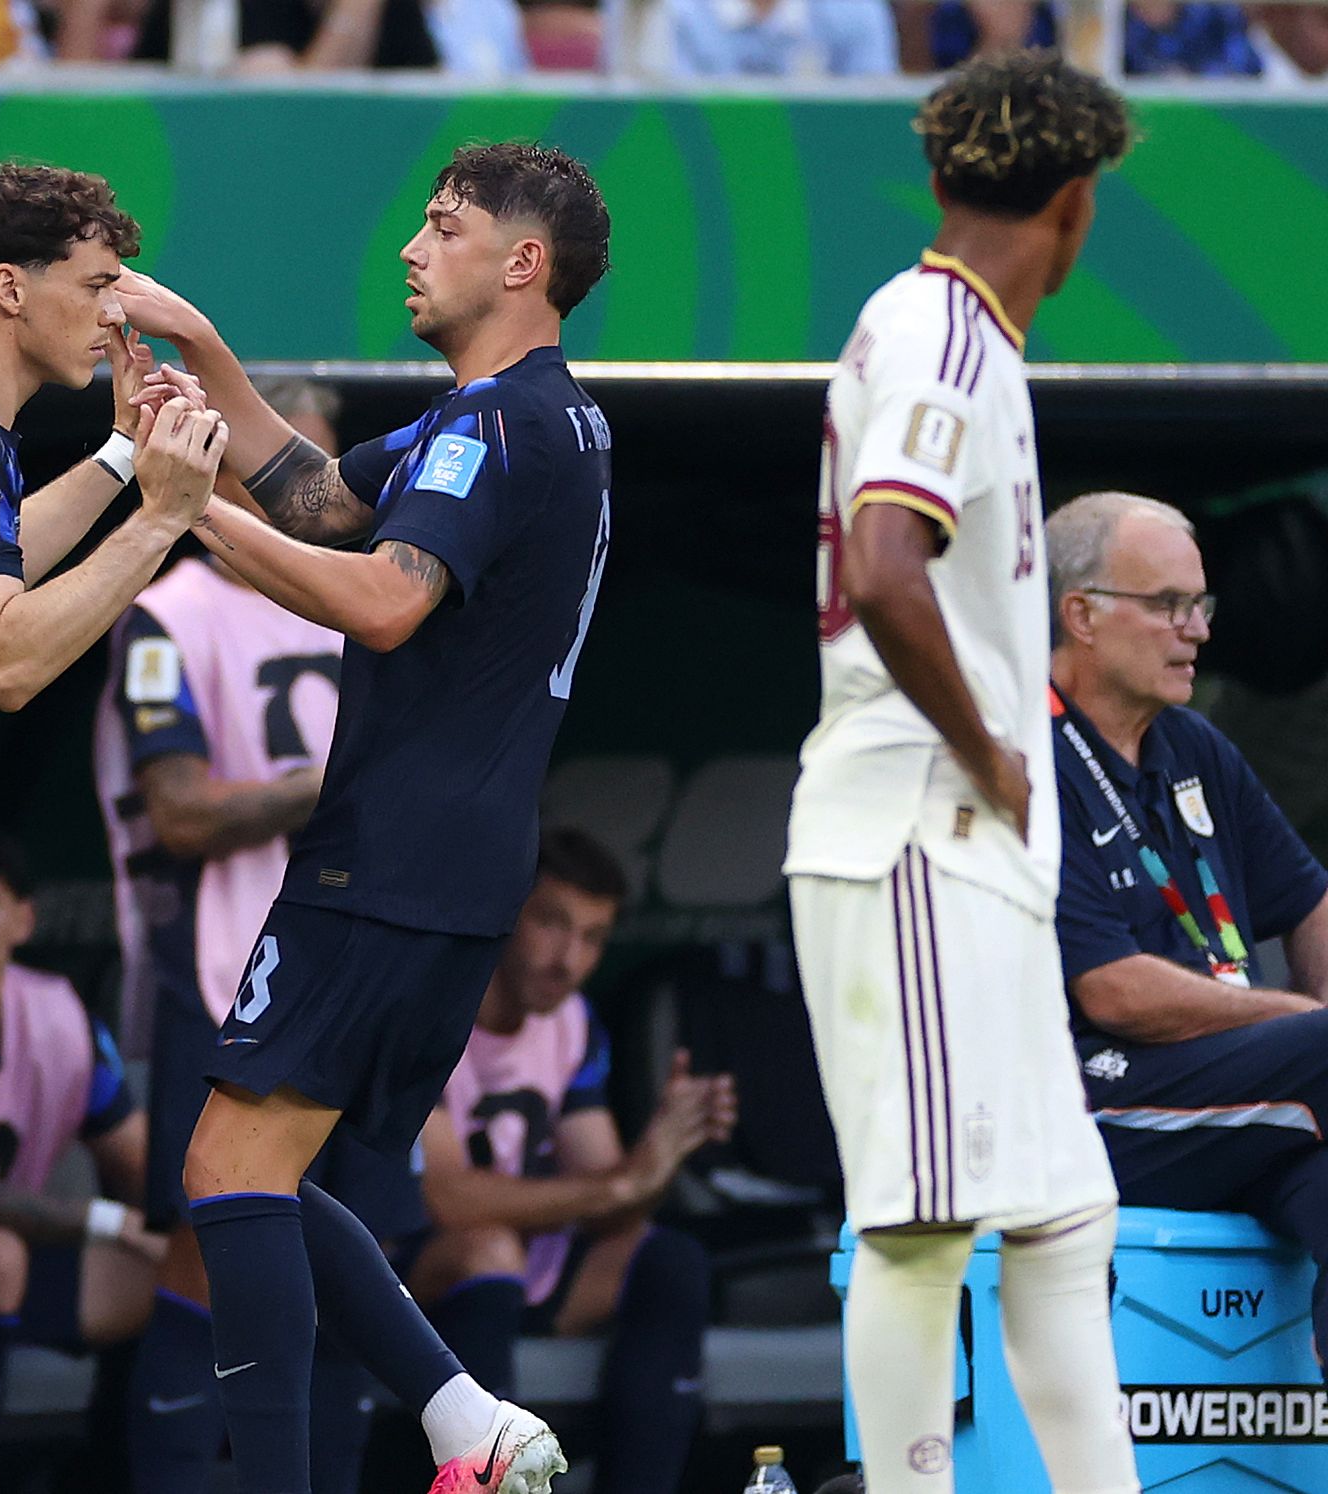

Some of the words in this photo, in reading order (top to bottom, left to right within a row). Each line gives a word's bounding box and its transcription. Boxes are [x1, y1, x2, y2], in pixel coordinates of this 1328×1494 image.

[1086, 758, 1105, 780] CUP
[1099, 777, 1126, 818] WORLD
[235, 935, 280, 1024] 8
[1202, 1289, 1264, 1318] URY
